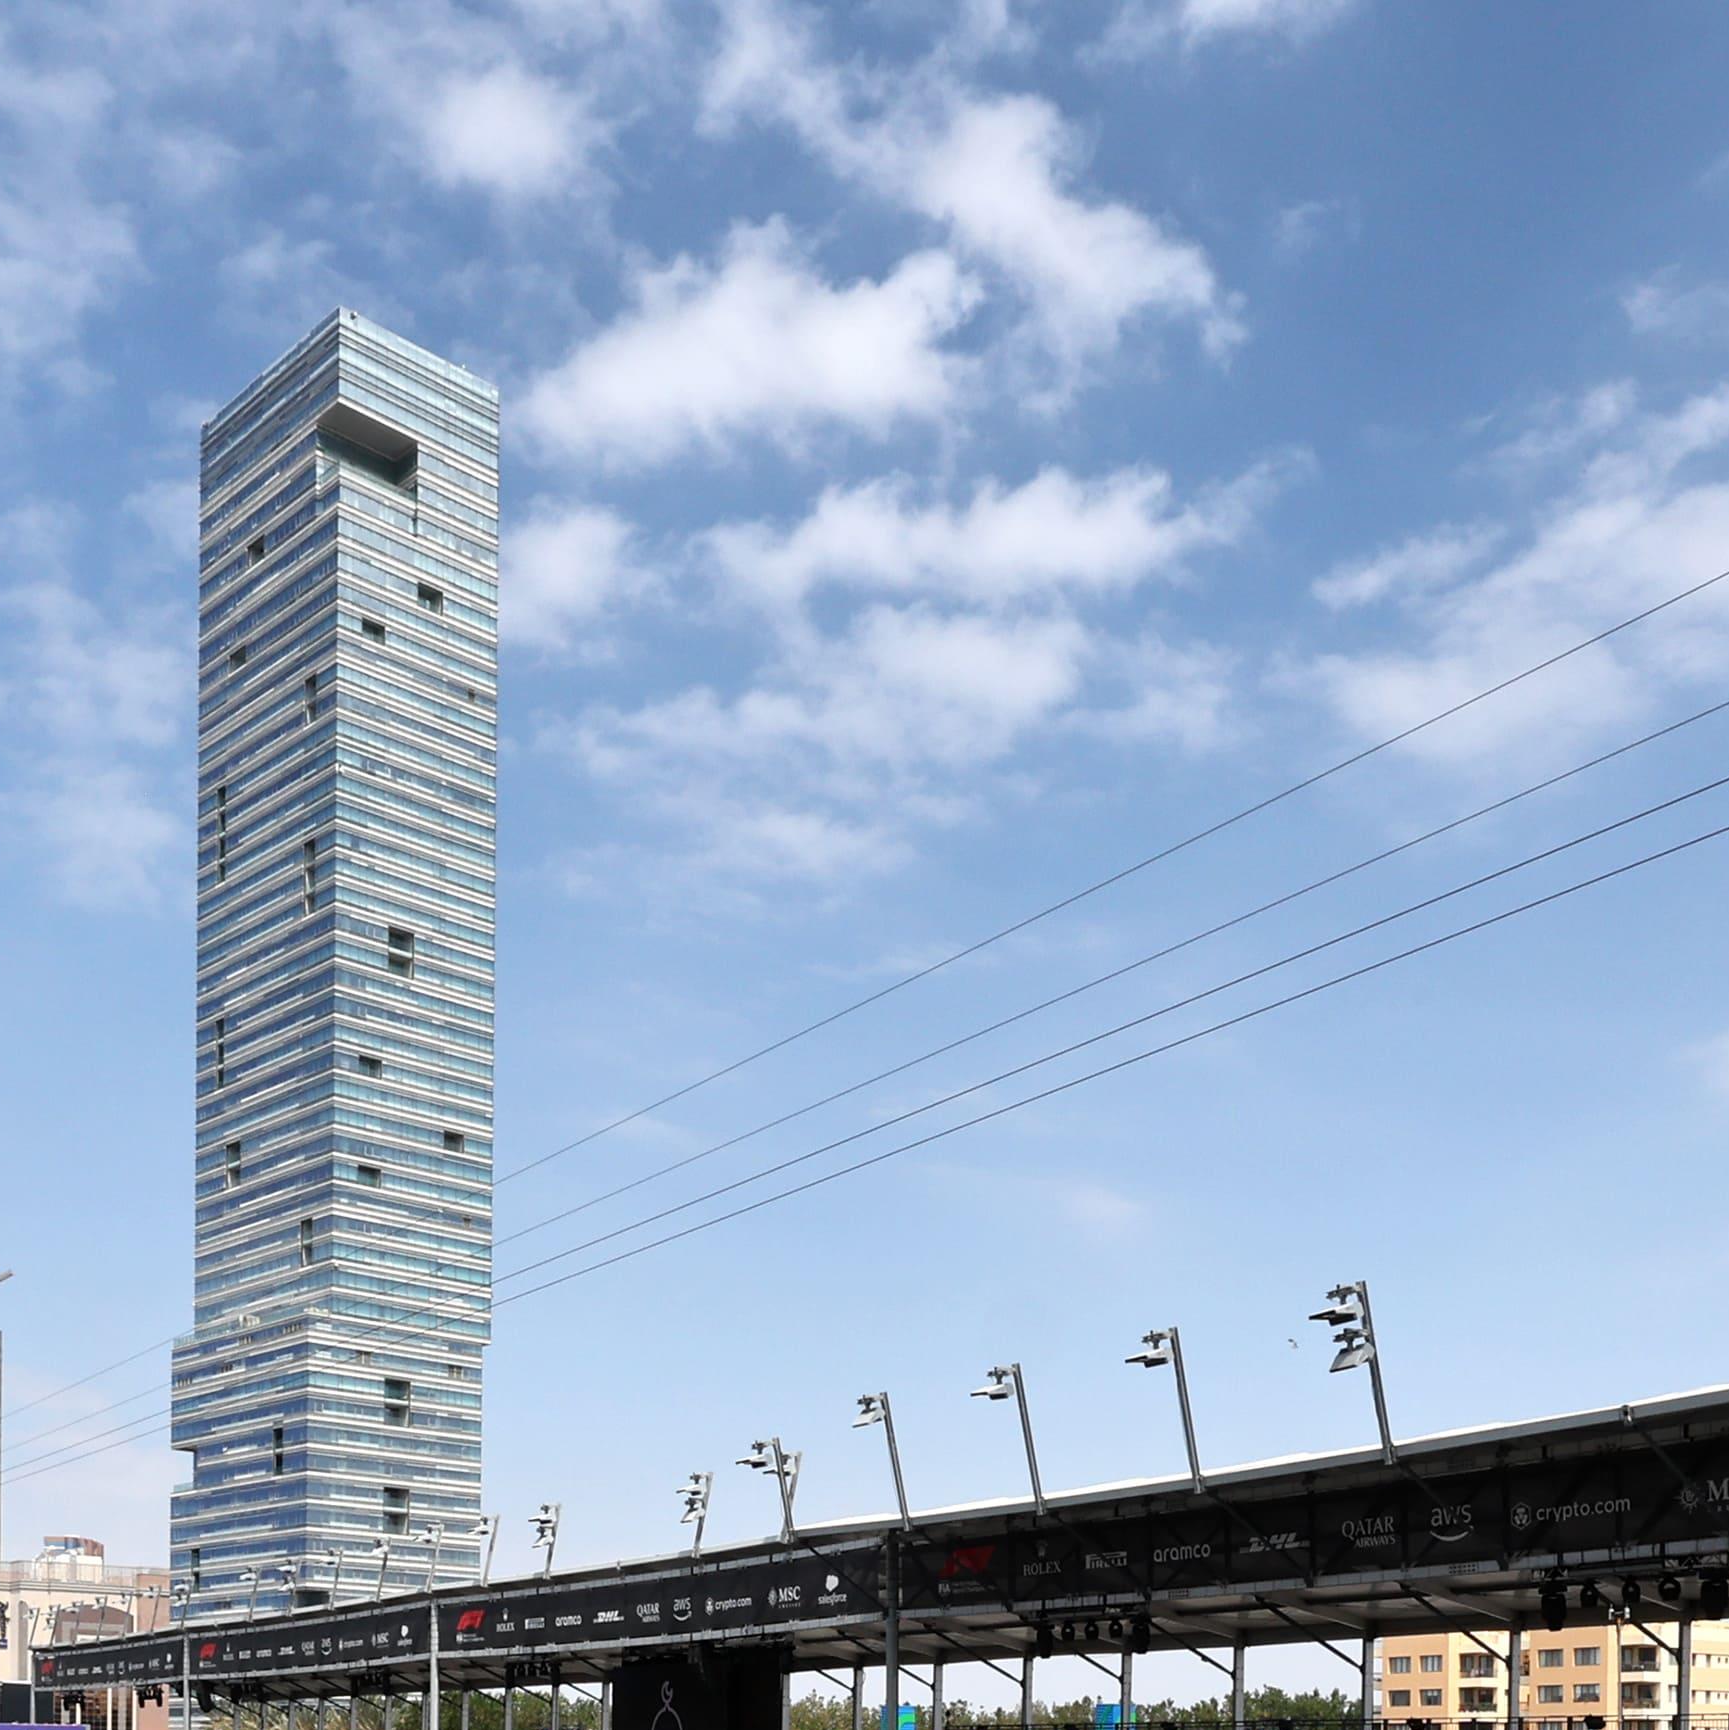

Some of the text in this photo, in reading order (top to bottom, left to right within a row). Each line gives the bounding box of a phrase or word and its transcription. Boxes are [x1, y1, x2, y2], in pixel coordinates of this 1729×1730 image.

[1431, 1503, 1472, 1530] aws
[1535, 1497, 1631, 1524] crypto.com
[1342, 1515, 1395, 1541] QATAR
[1354, 1534, 1396, 1549] AIRWAYS
[1153, 1543, 1211, 1564] aramco
[1023, 1560, 1061, 1577] ROLEX
[778, 1585, 801, 1602] MSC
[715, 1597, 752, 1611] crypto.com
[556, 1615, 582, 1627] aramco
